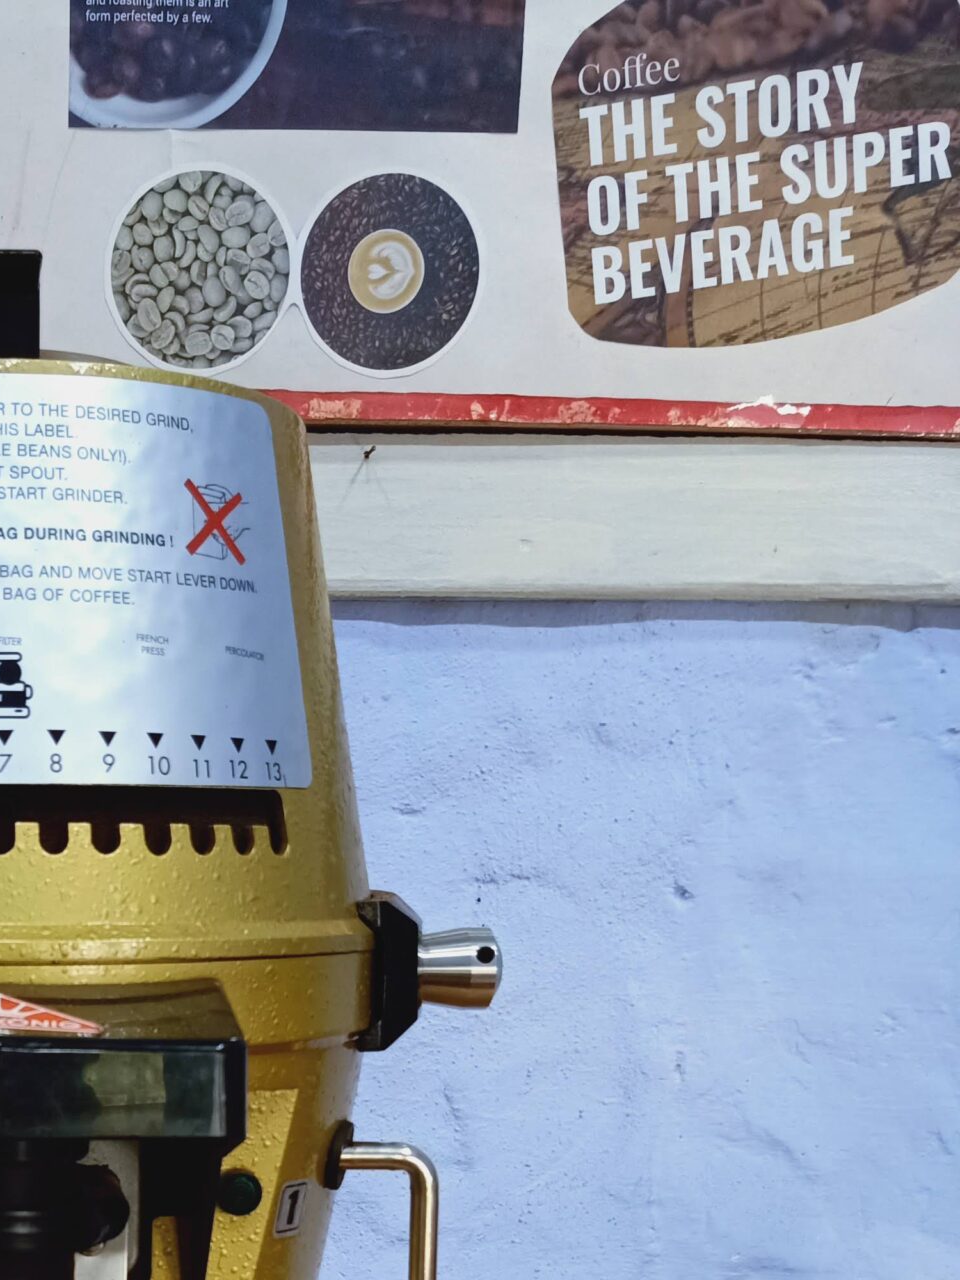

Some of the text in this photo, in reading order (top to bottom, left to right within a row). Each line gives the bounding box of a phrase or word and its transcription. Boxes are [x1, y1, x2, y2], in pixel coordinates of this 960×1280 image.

[86, 9, 213, 26] form perfected by a few.
[578, 53, 680, 95] Coffee
[579, 61, 864, 166] THE STORY
[587, 121, 952, 236] OF THE SUPER
[591, 206, 855, 305] BEVERAGE
[13, 402, 32, 416] TO
[40, 403, 68, 418] THE
[75, 406, 141, 424] DESIRED
[146, 413, 194, 433] GRIND,
[17, 443, 71, 459] BEANS
[77, 446, 131, 466] ONLY!).
[9, 466, 68, 481] SPOUT.
[52, 488, 128, 505] GRINDER.
[24, 528, 87, 542] DURING
[0, 565, 33, 578] BAG
[39, 565, 73, 579] AND
[78, 567, 123, 581] MOVE
[128, 569, 172, 585] START
[176, 573, 216, 588] LEVER
[219, 577, 258, 593] DOWN.
[2, 587, 36, 600] BAG
[43, 588, 63, 601] OF
[70, 589, 136, 605] COFFEE.
[136, 633, 169, 645] FRENCH
[141, 646, 166, 656] PRESS
[50, 753, 63, 773] 8
[103, 754, 115, 773] 9
[148, 755, 171, 776] 10
[193, 759, 211, 778] 11
[229, 760, 248, 779] 12
[265, 762, 282, 781] 13
[288, 1190, 300, 1225] 1
